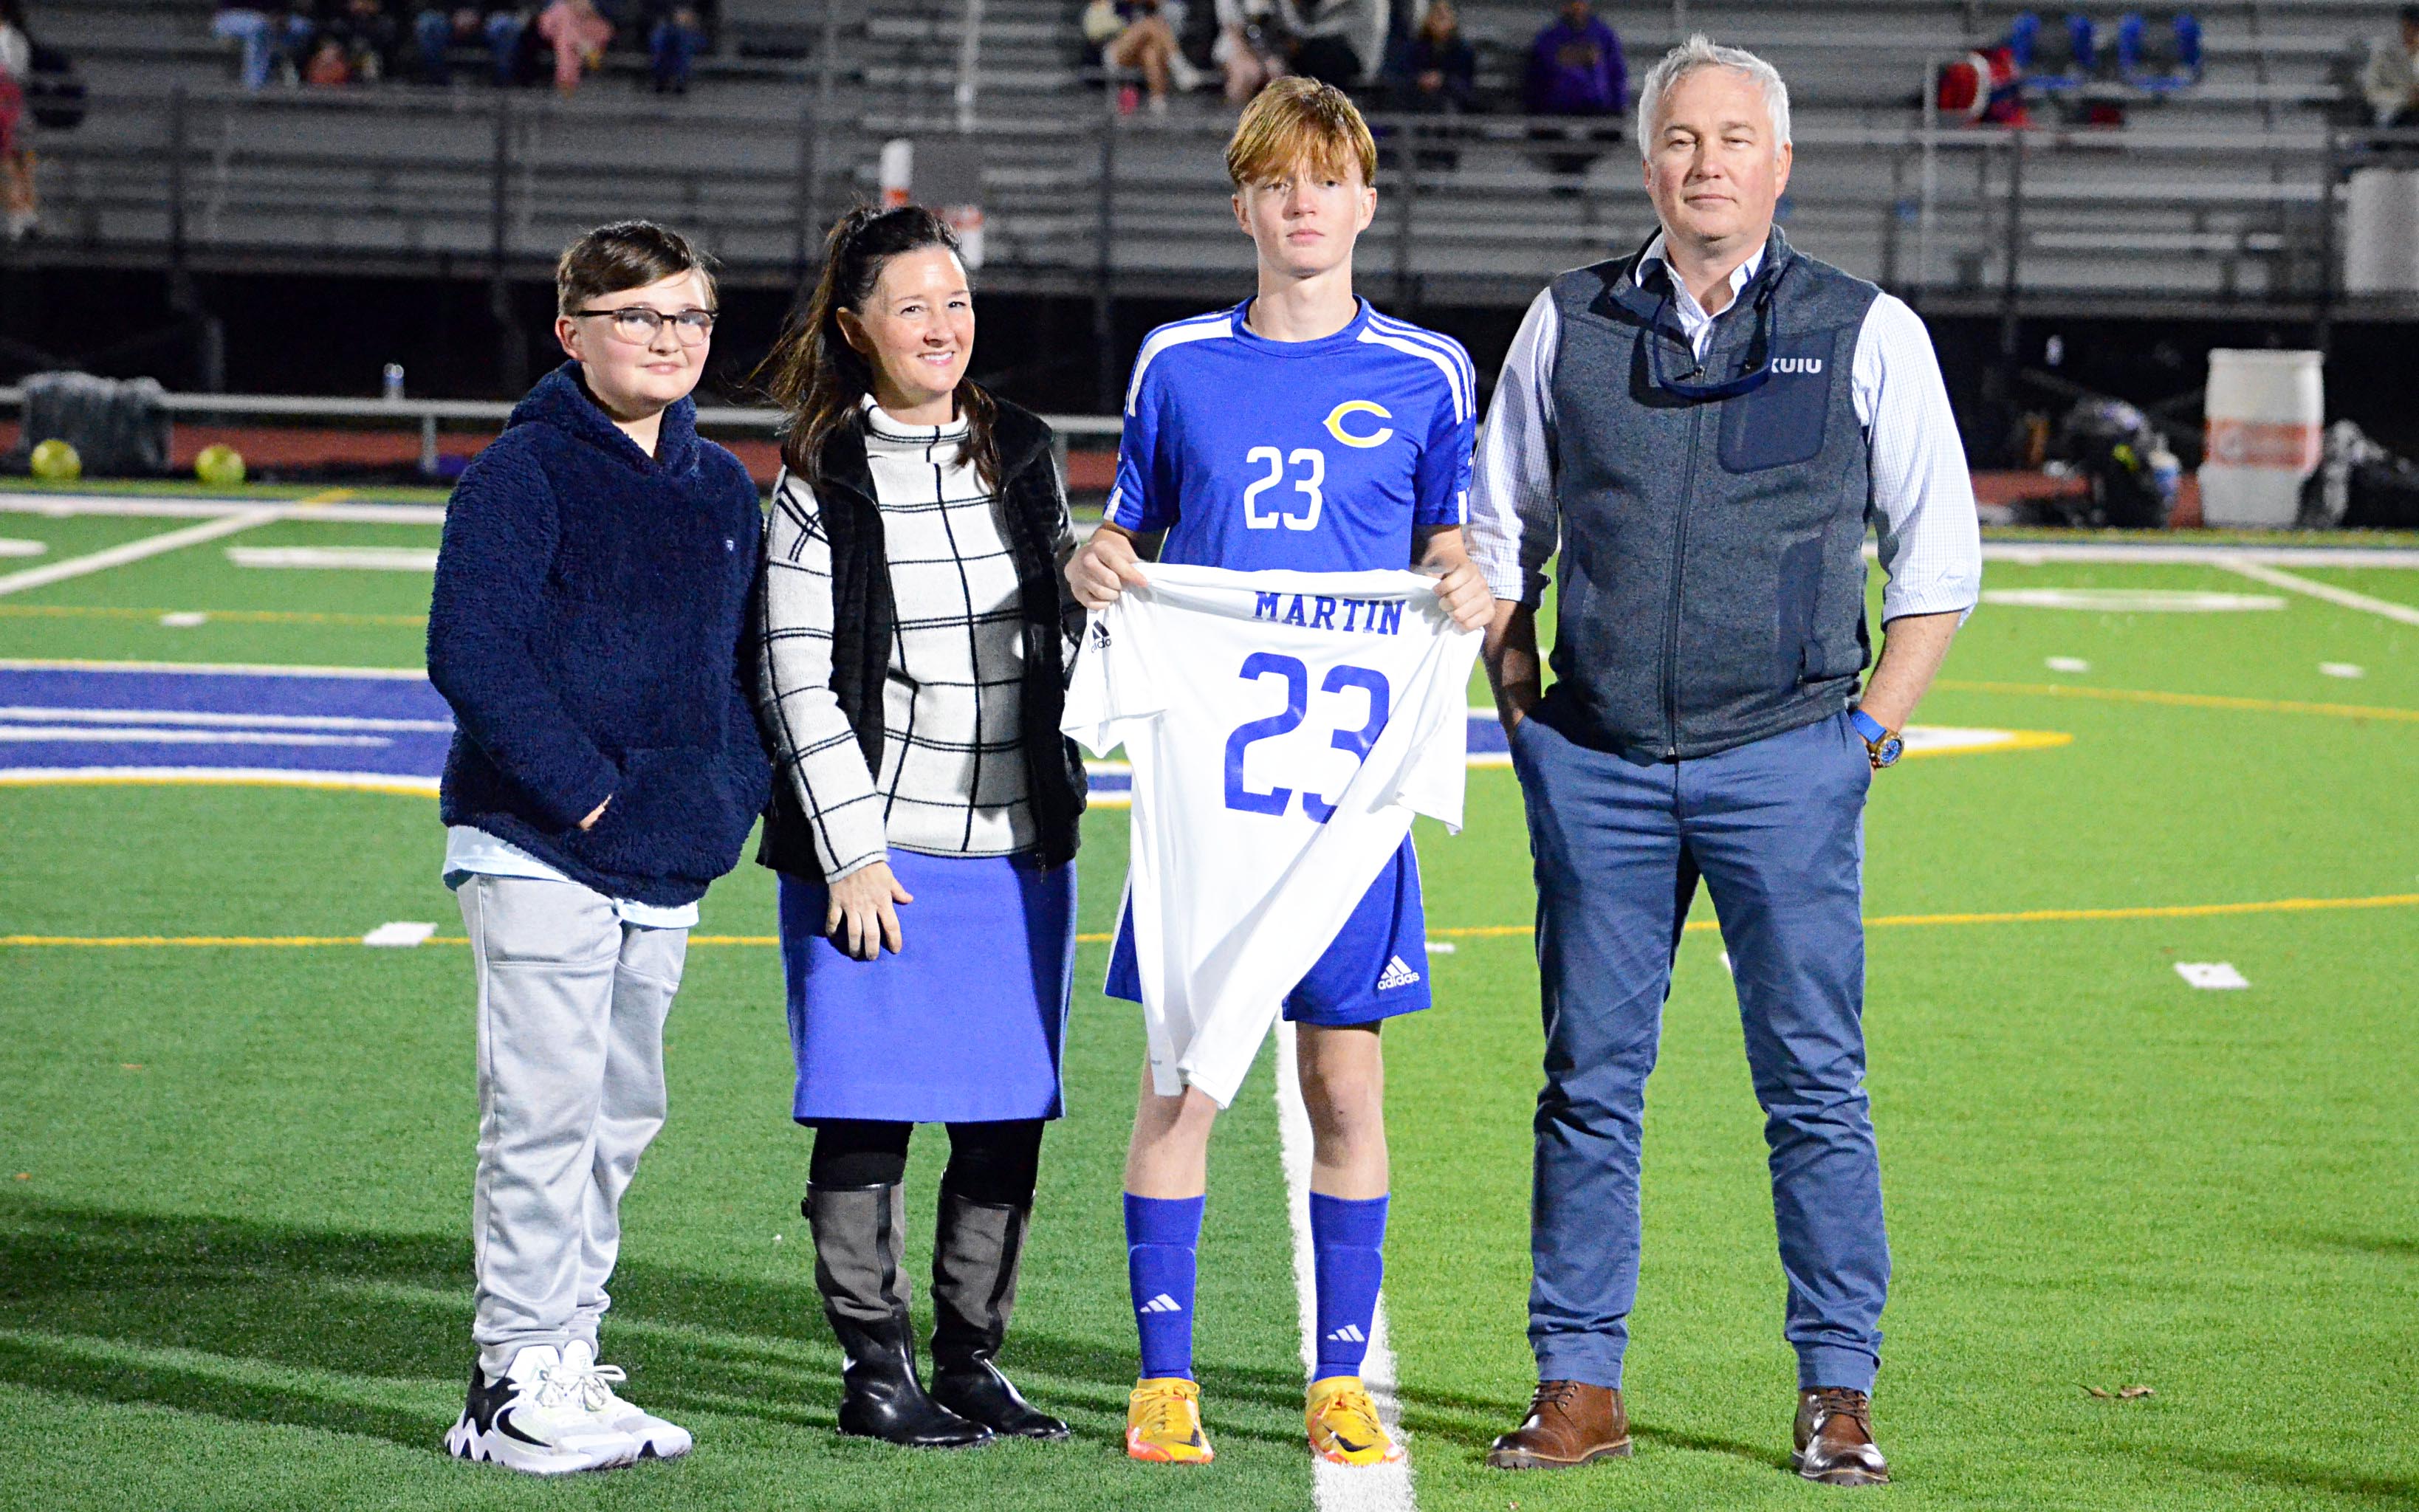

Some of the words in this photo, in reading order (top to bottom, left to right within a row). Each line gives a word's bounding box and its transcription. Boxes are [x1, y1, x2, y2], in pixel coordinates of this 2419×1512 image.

[1243, 446, 1325, 531] 23
[1252, 591, 1406, 636] MARTIN
[1224, 652, 1390, 824] 23
[1378, 972, 1420, 990] adidas
